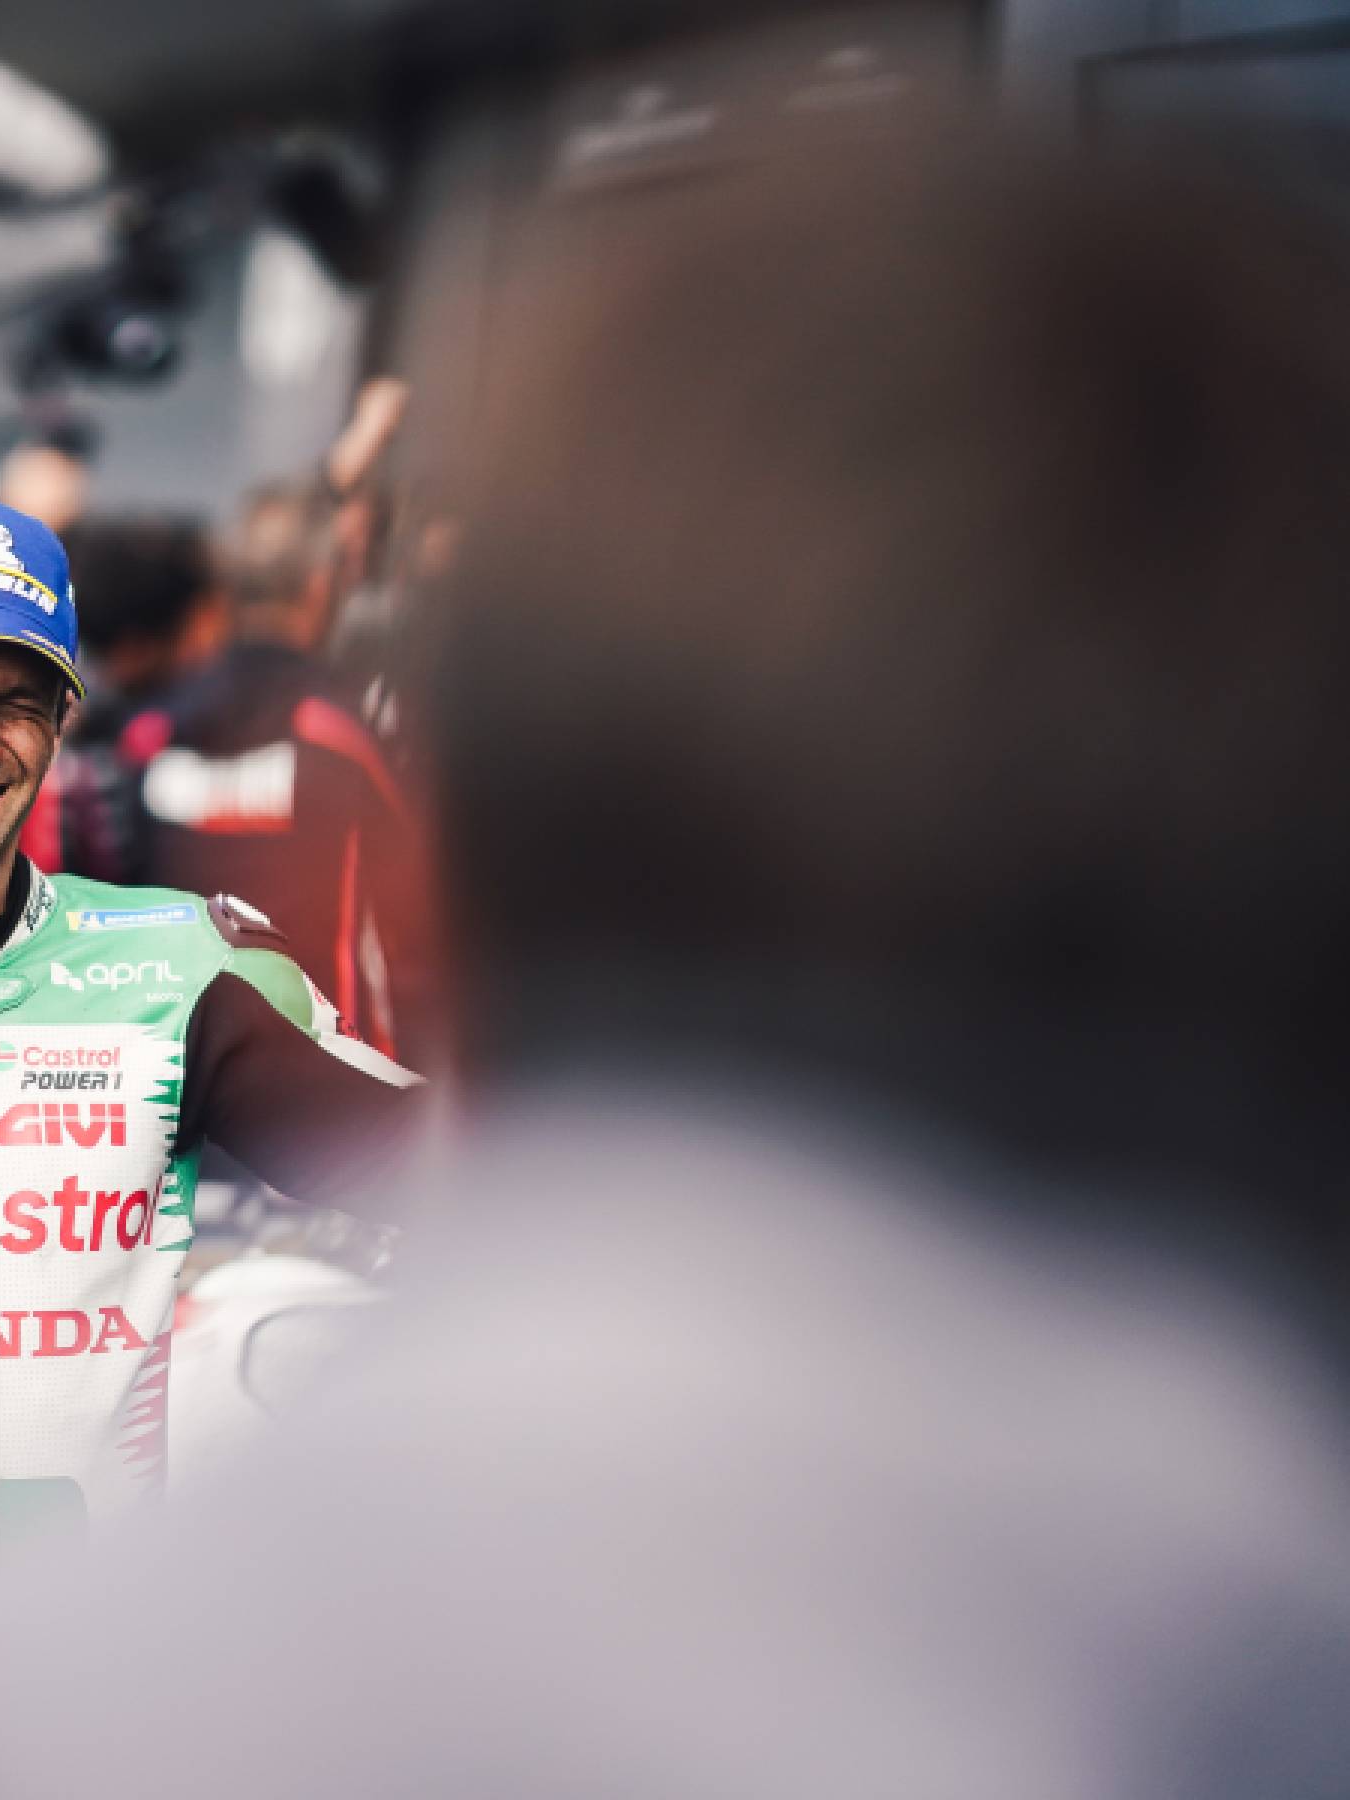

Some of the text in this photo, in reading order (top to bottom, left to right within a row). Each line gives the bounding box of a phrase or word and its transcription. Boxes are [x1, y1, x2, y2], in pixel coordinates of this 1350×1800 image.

[85, 959, 184, 991] april
[23, 1046, 121, 1067] Castrol
[20, 1071, 109, 1090] POWER
